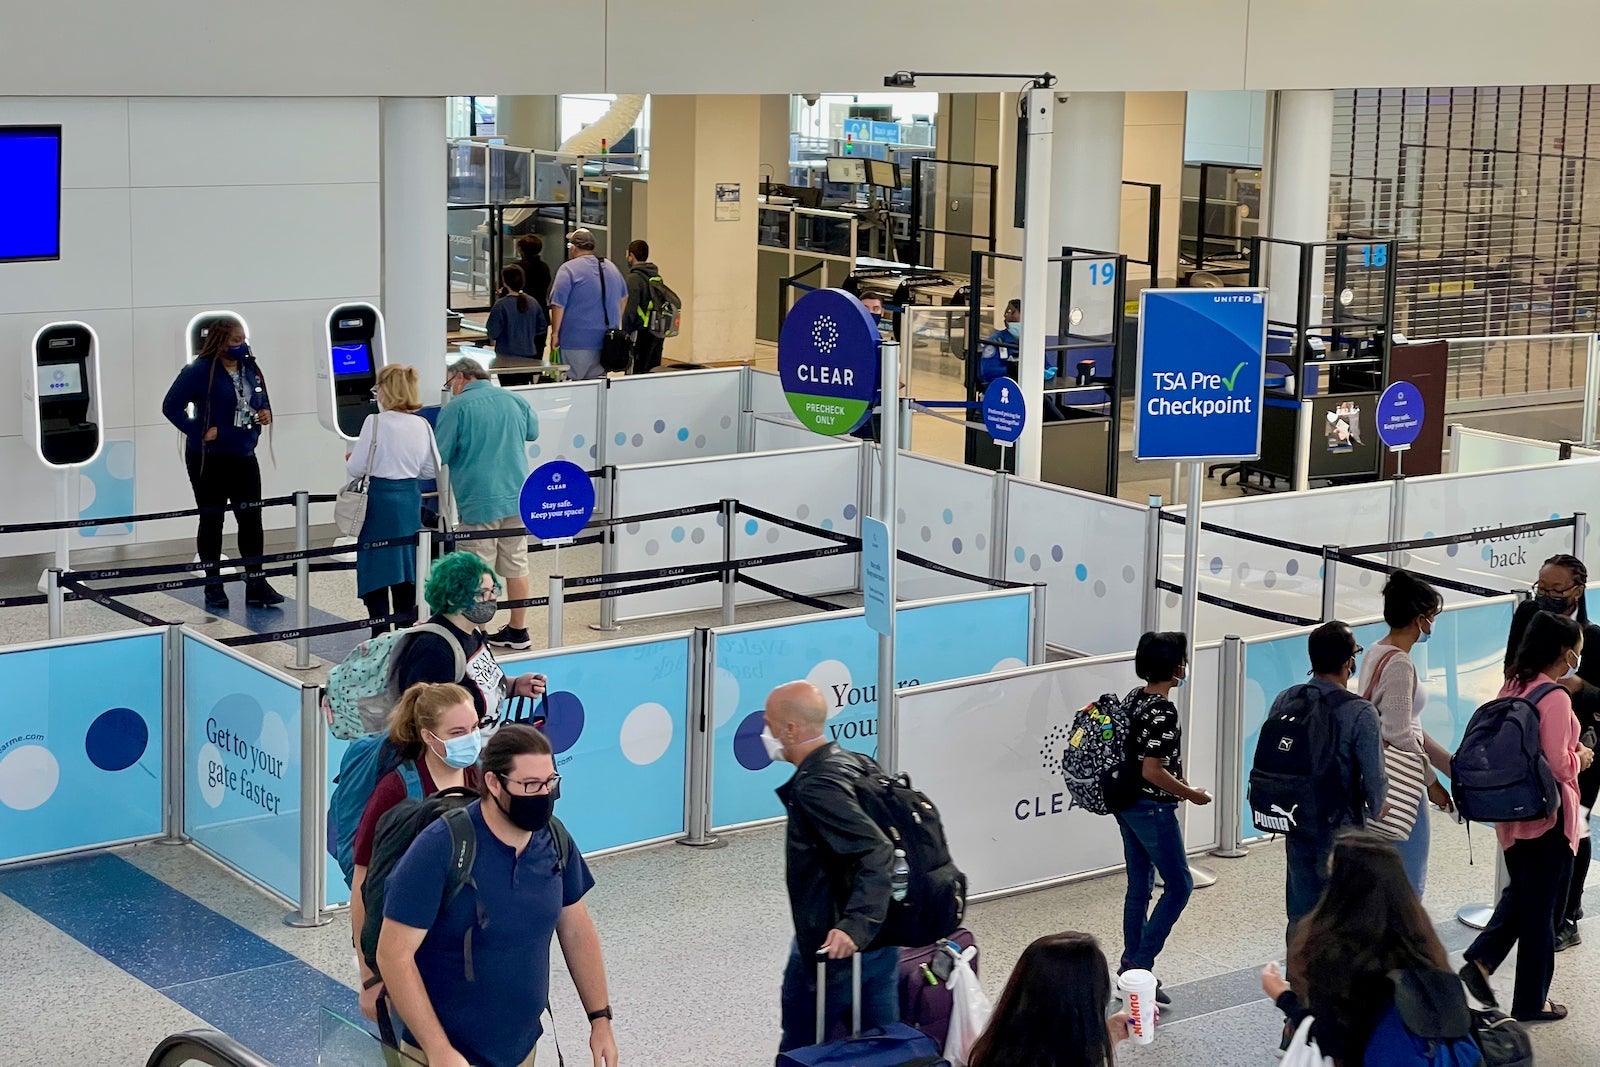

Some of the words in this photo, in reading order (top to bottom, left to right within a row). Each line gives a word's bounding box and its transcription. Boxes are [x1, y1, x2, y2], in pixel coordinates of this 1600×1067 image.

[1361, 244, 1387, 267] 18
[1089, 262, 1114, 286] 19
[797, 364, 854, 386] CLEAR
[1152, 372, 1188, 390] TSA
[1191, 372, 1220, 390] Pre
[806, 402, 845, 416] PRECHECK
[1148, 396, 1252, 418] Checkpoint
[816, 415, 835, 425] ONLY
[542, 502, 556, 510] Stay
[557, 500, 573, 508] safe.
[548, 510, 564, 519] your
[564, 506, 584, 517] space!
[1490, 546, 1526, 568] back
[832, 683, 878, 708] You
[206, 718, 230, 752] Get
[234, 733, 247, 760] to
[250, 745, 282, 779] your
[557, 756, 573, 766] com
[208, 760, 236, 791] gate
[240, 768, 280, 816] faster
[1015, 793, 1079, 820] CLEA
[1254, 810, 1290, 831] PUMA
